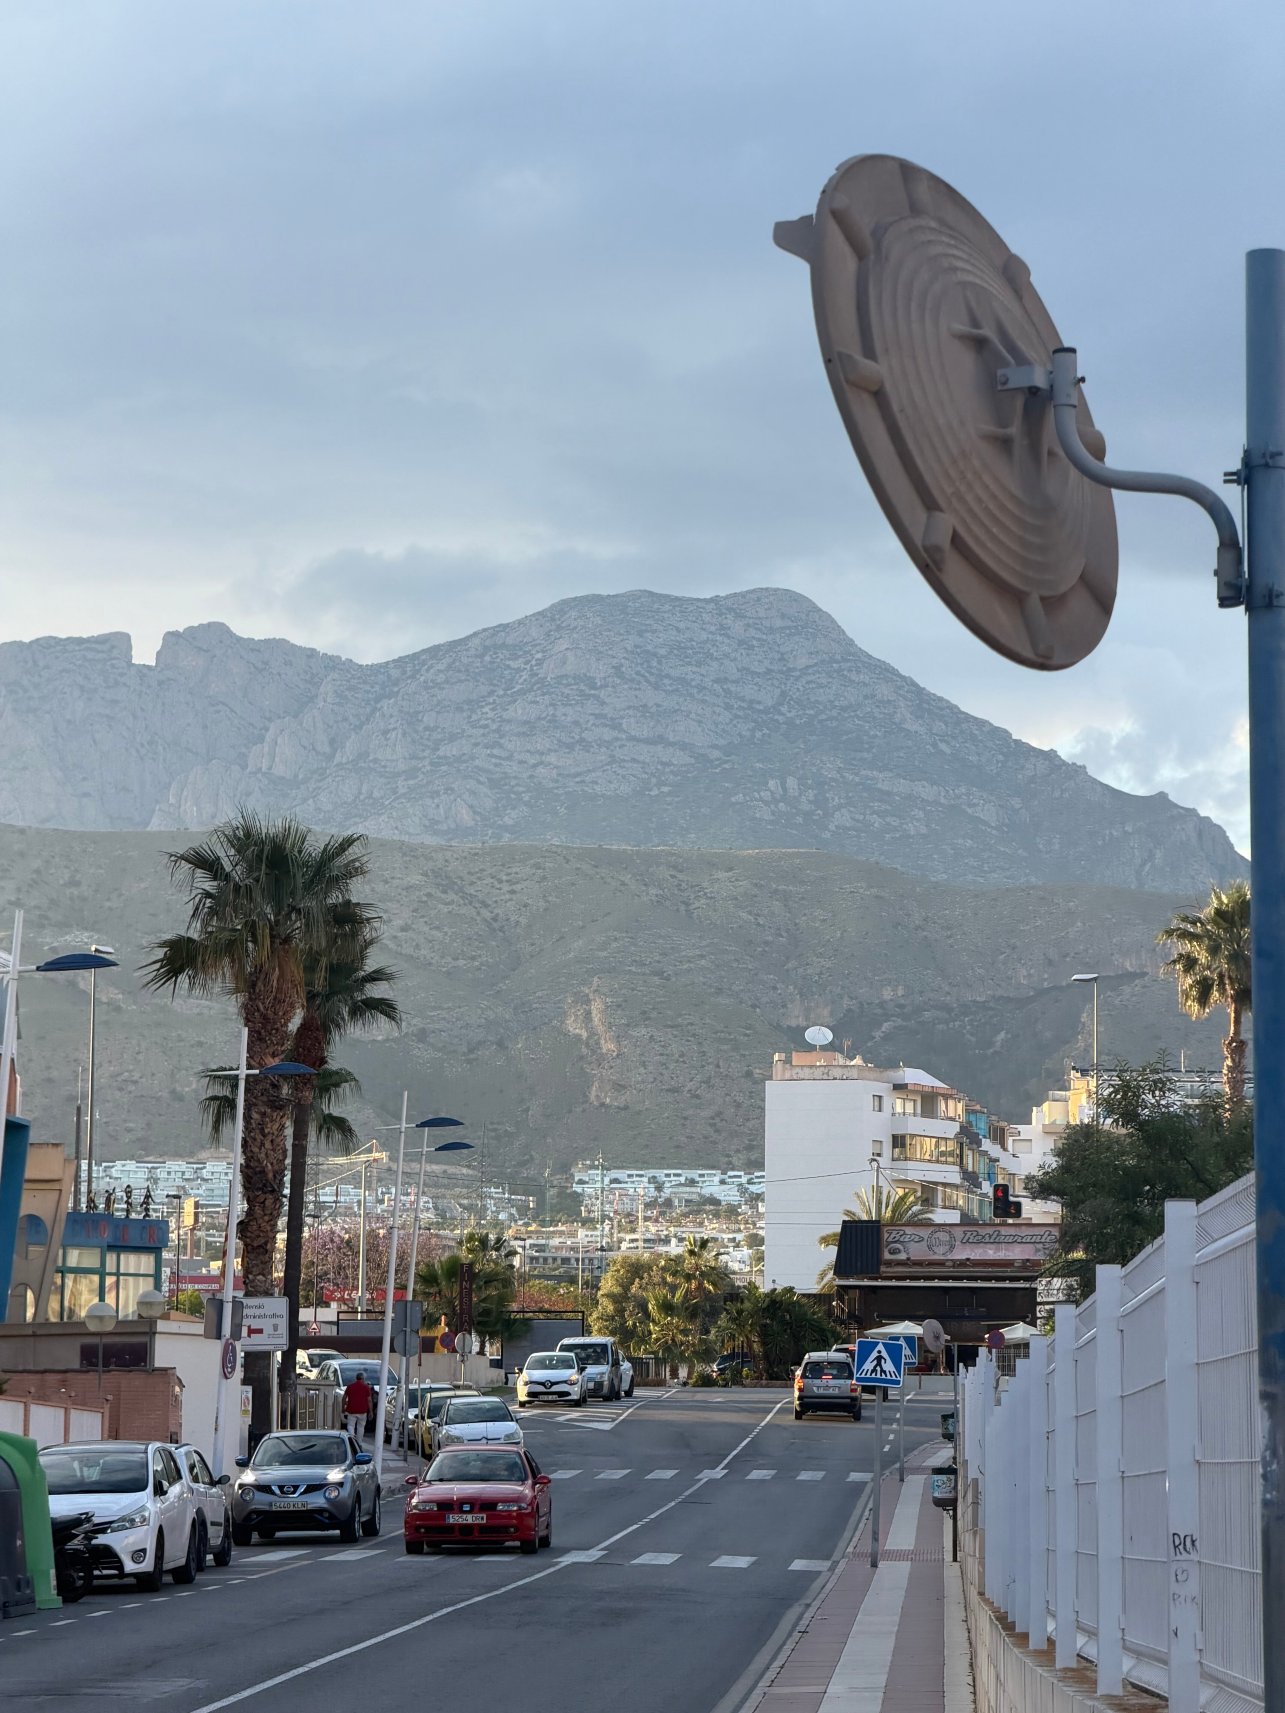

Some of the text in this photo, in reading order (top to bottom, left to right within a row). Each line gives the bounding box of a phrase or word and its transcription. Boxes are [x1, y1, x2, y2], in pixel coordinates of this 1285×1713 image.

[886, 1229, 924, 1243] Bar
[961, 1230, 1057, 1243] Restaurante
[243, 1312, 285, 1320] dministrativa
